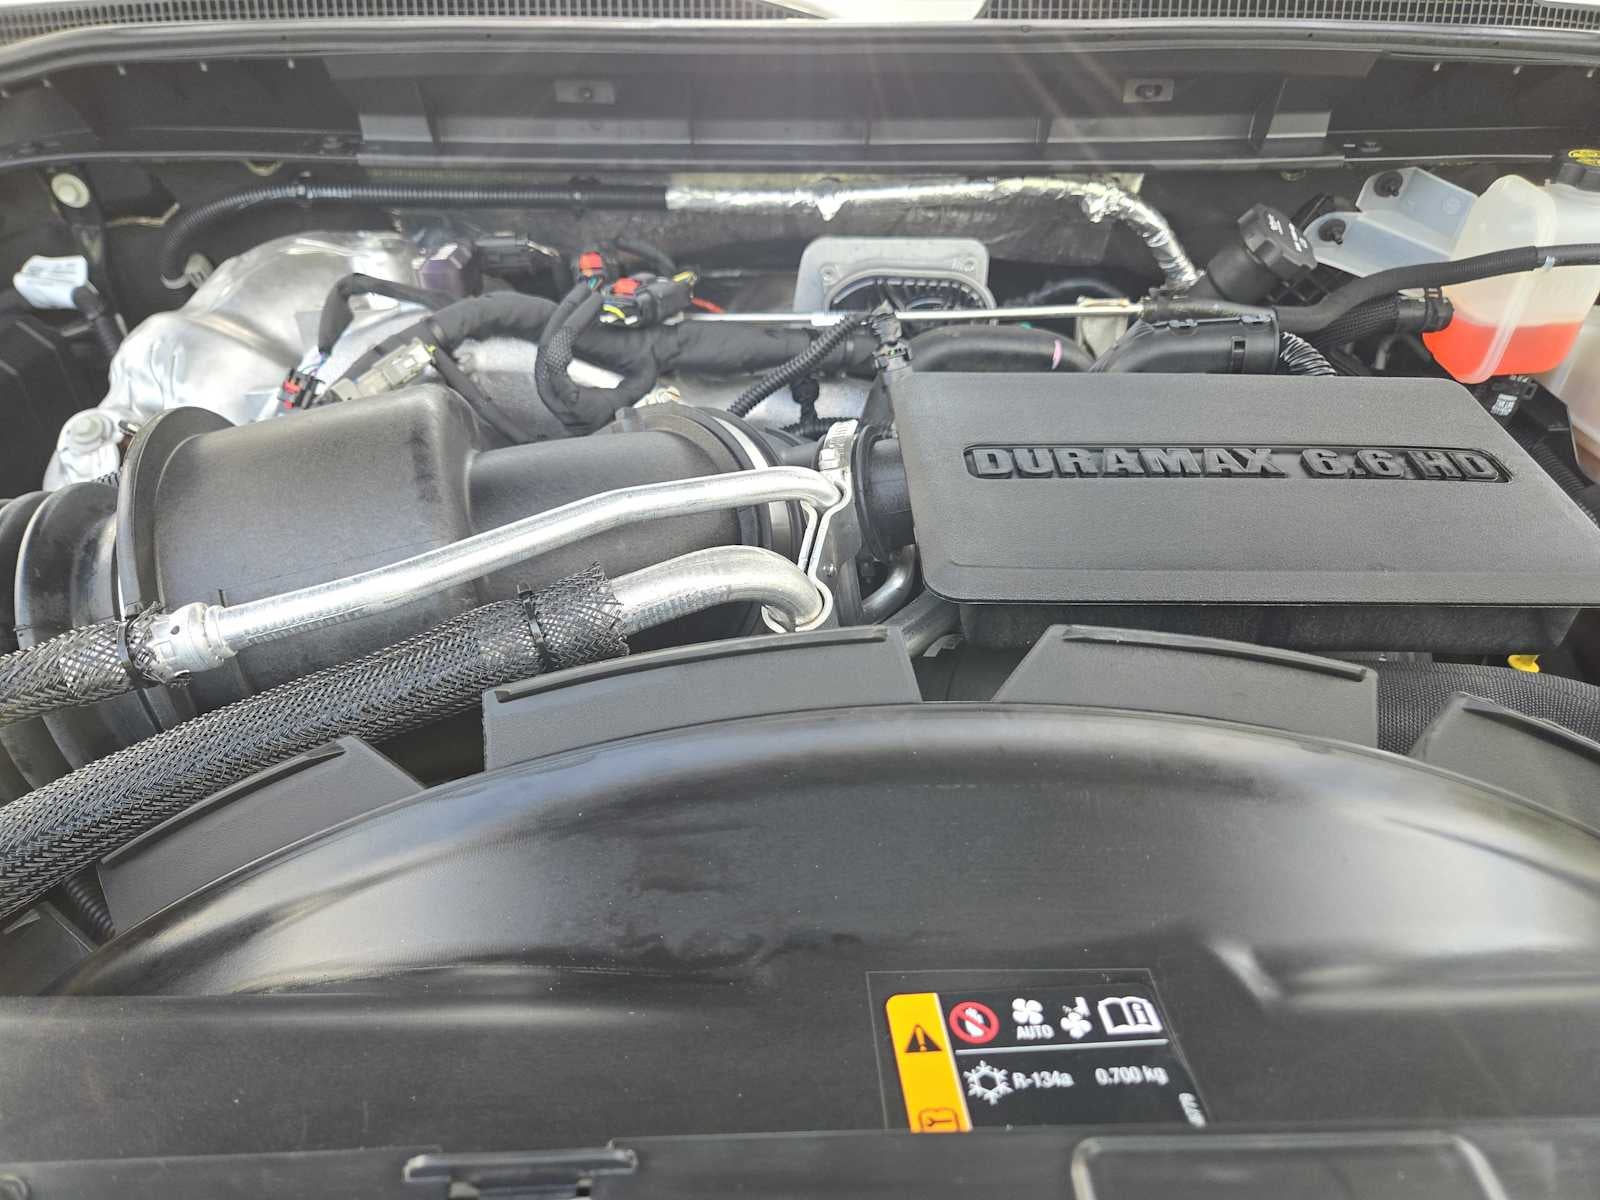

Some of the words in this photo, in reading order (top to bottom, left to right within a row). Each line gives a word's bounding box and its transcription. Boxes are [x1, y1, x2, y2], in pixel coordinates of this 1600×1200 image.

[973, 447, 1288, 479] DURAMAX
[1301, 447, 1401, 479] 6.6
[1406, 450, 1500, 482] HD
[1016, 1025, 1054, 1040] AUTO
[1012, 1070, 1074, 1089] R-134a
[1095, 1066, 1140, 1085] 0.700
[1141, 1065, 1168, 1085] kg
